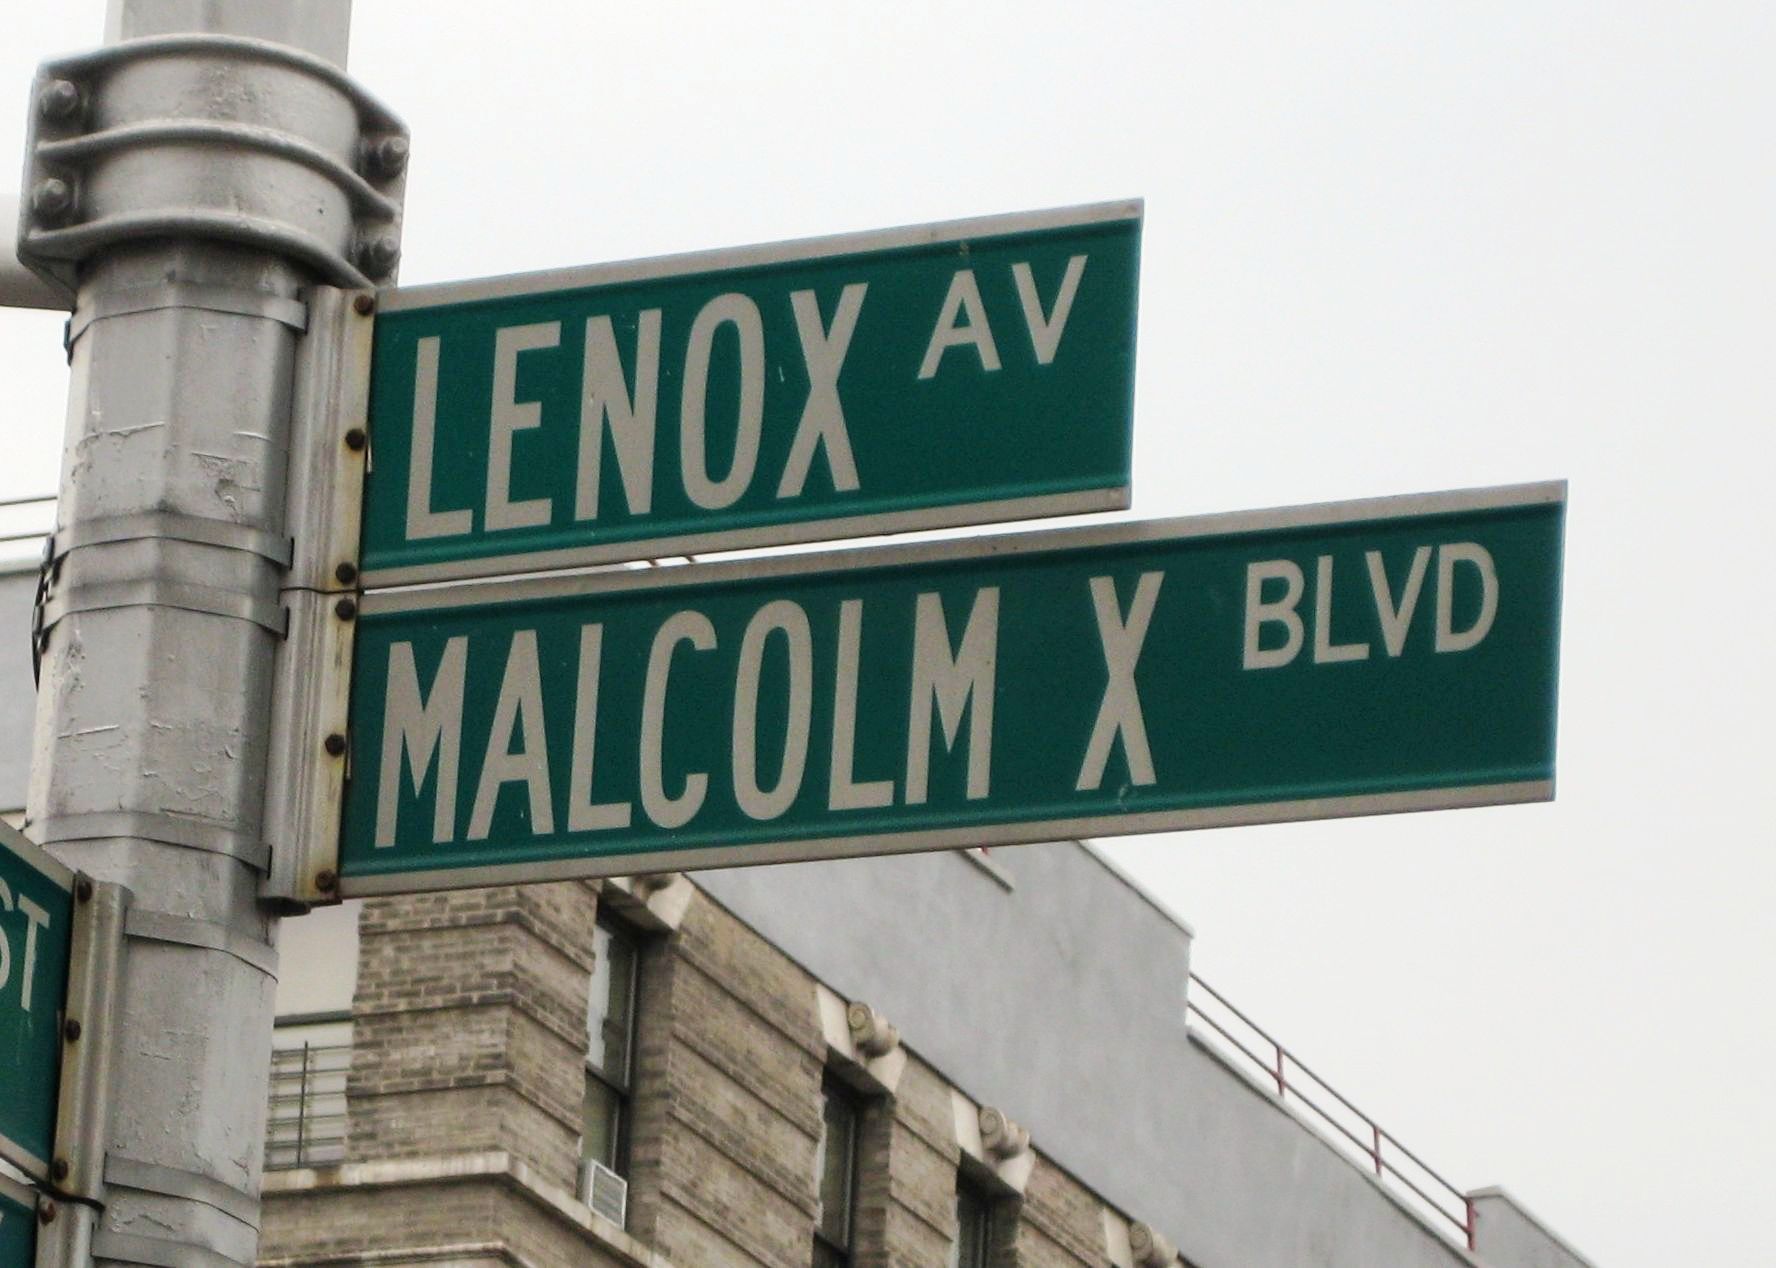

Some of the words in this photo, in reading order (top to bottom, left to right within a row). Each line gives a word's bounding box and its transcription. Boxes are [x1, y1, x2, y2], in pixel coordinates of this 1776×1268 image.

[404, 282, 868, 541] LENOX
[916, 254, 1089, 381] AV
[374, 586, 1001, 849] MALCOLM
[1074, 570, 1166, 791] X
[1242, 541, 1500, 671] BLVD
